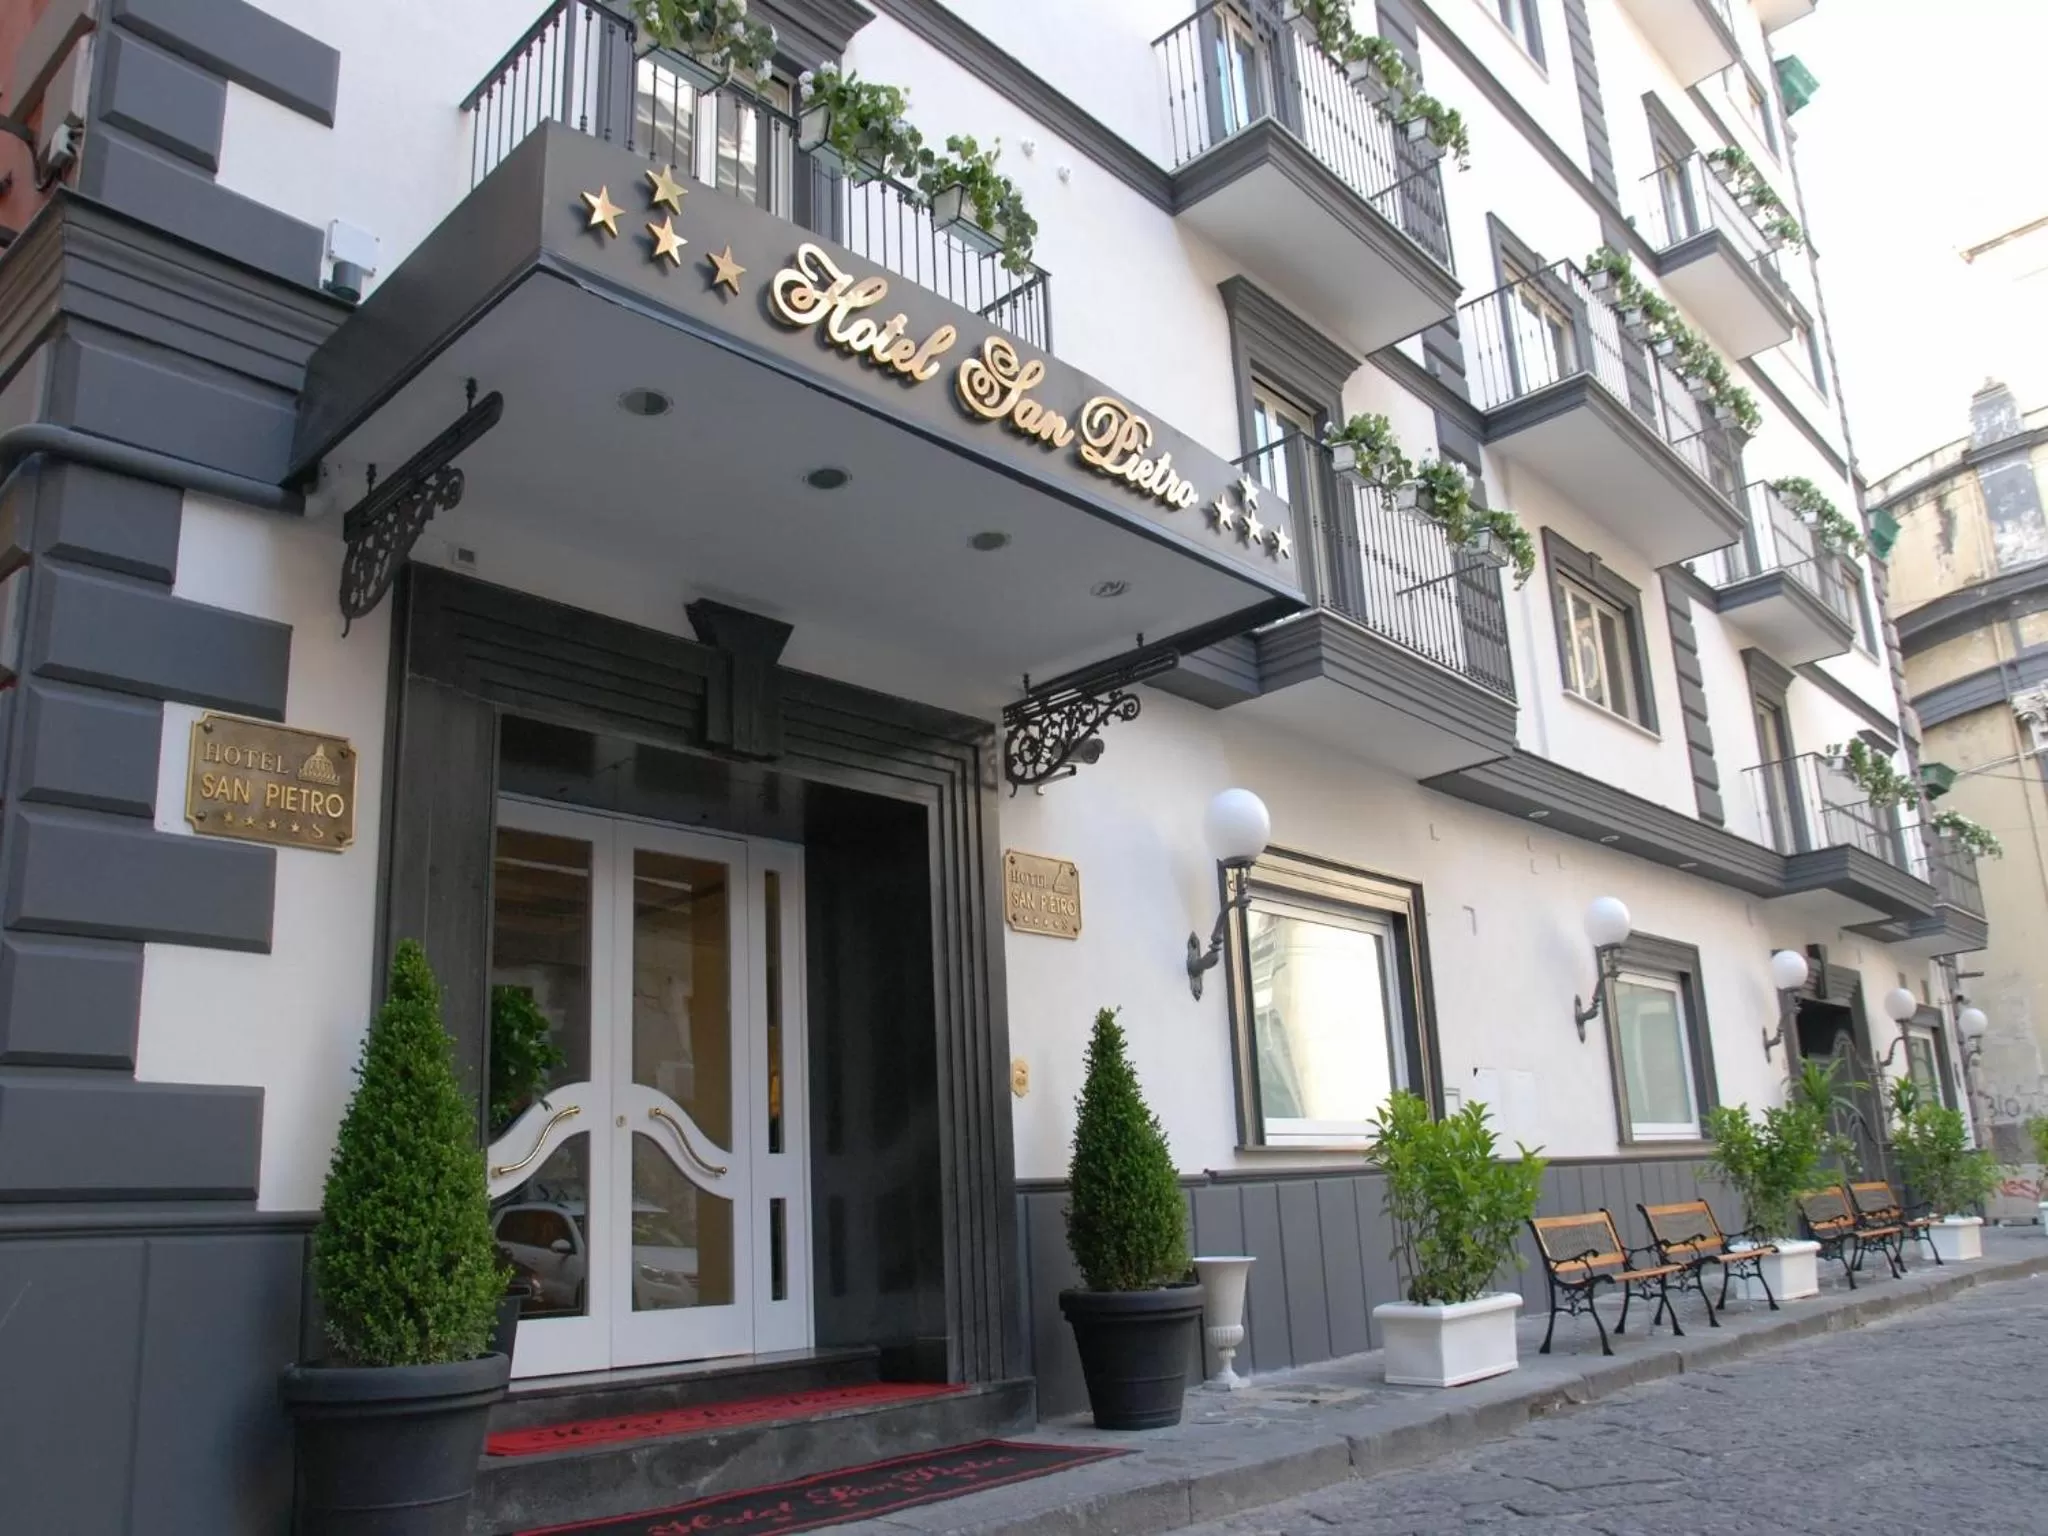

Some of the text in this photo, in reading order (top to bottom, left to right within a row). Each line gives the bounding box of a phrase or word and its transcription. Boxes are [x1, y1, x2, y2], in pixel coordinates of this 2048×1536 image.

[771, 242, 1199, 509] Hotel San Pietro
[202, 742, 289, 775] HOTEL
[201, 772, 344, 819] SAN PIETRO
[1011, 889, 1035, 911] SAN
